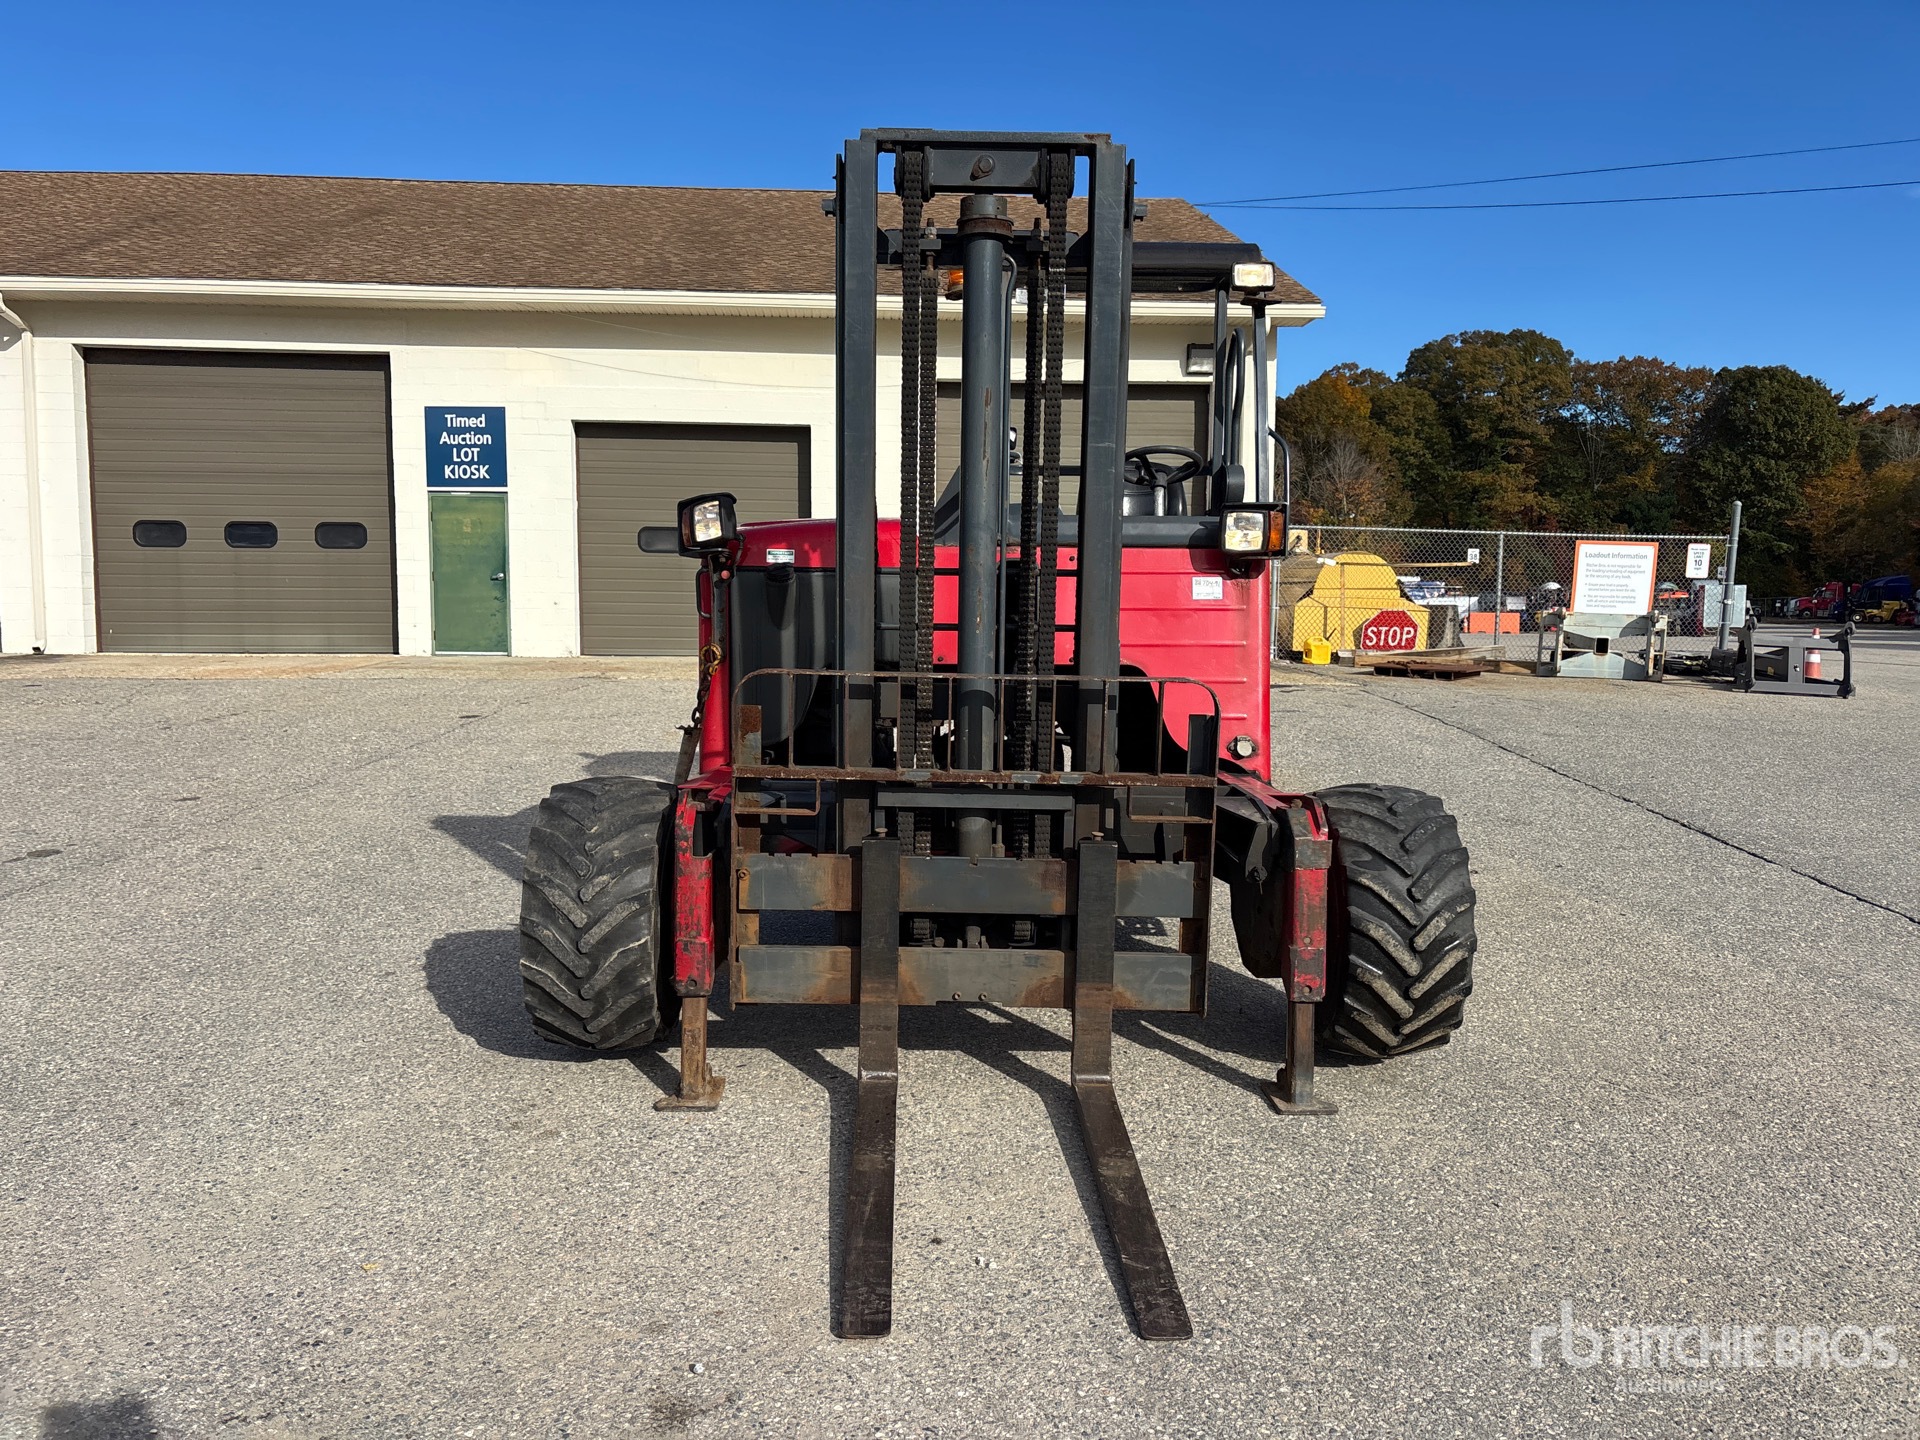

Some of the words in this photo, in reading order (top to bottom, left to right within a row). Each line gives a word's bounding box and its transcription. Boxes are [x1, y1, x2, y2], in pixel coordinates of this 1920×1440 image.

[445, 414, 485, 428] Timed
[439, 431, 492, 445] Auction
[453, 447, 480, 462] LOT
[444, 465, 490, 479] KIOSK
[1468, 553, 1478, 561] 38
[1585, 551, 1610, 559] Loadout
[1611, 552, 1648, 560] Information
[1694, 559, 1703, 567] 10
[1365, 626, 1415, 647] STOP
